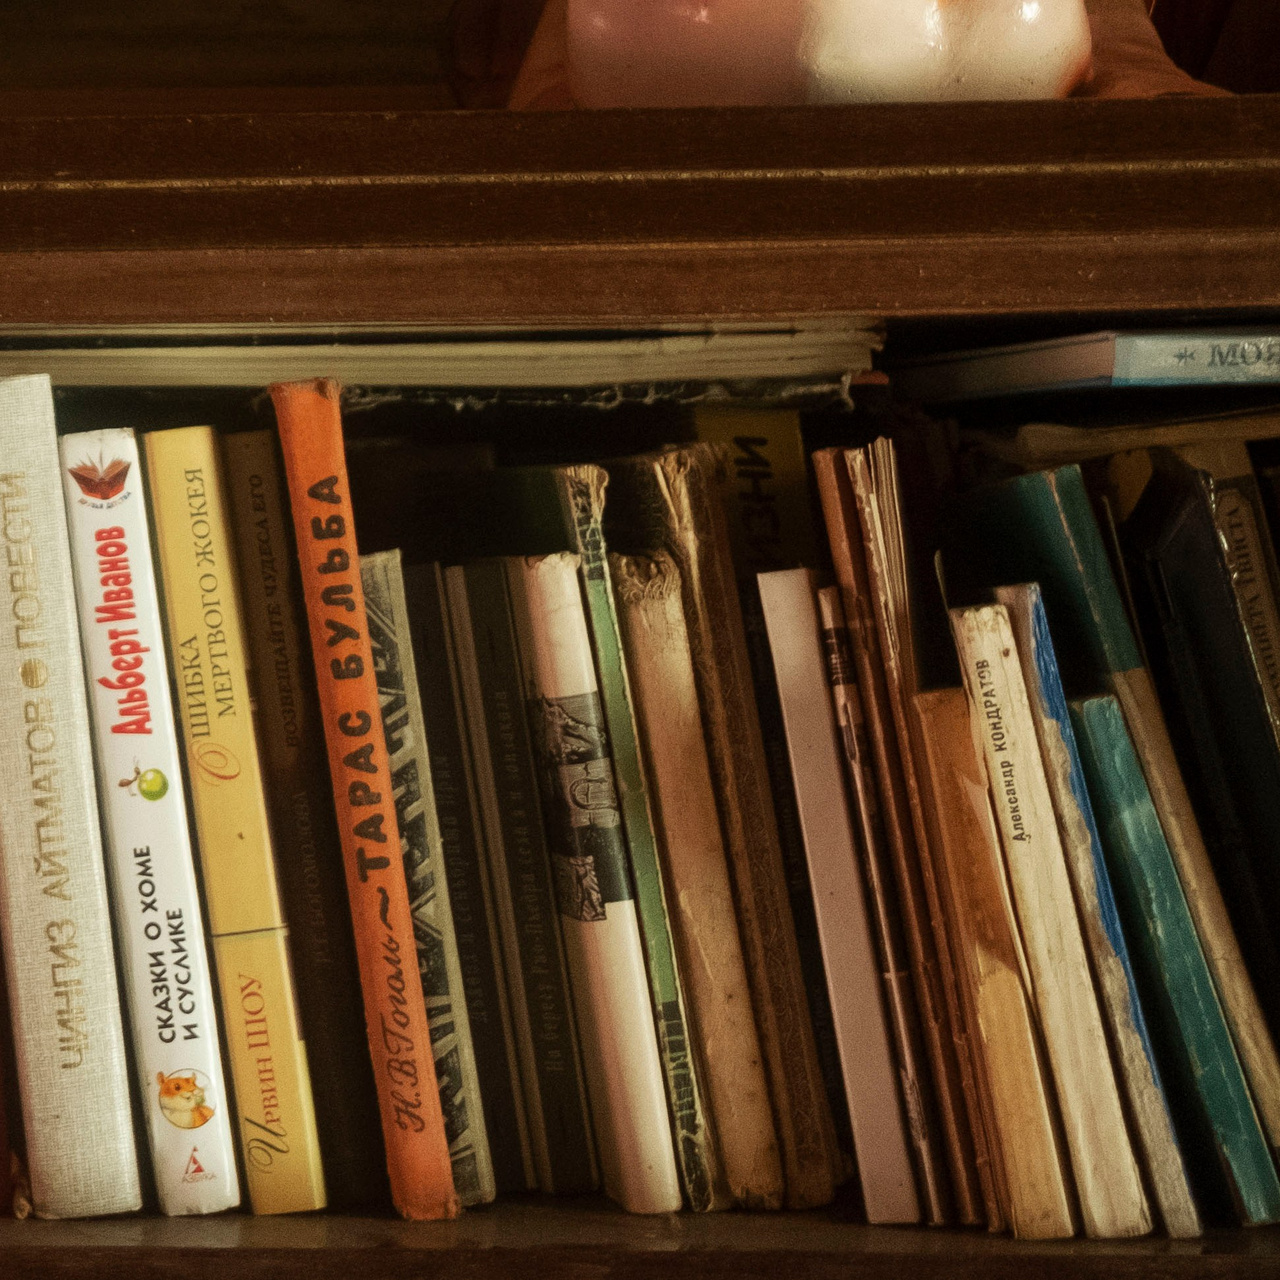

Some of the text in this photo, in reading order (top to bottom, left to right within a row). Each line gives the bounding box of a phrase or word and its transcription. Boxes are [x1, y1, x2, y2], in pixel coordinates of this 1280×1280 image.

[248, 474, 267, 513] ЕГО
[254, 517, 279, 598] ЧУДЕСА
[307, 475, 365, 681] БУЛЬБА
[94, 525, 154, 734] Альберт Иванов
[183, 468, 237, 717] МЕРТВОГО ЖОКЕЯ
[265, 602, 301, 748] ВОЗВЕЩАЙТЕ
[24, 696, 72, 902] АЙТМАТОВ
[338, 708, 390, 884] ТАРАС
[976, 658, 1028, 843] Александр КОНДРАТОВ
[44, 918, 90, 1069] ЧИНГИЗ
[133, 845, 176, 1044] СКАЗКИ О ХОМЕ
[166, 907, 200, 1041] И СУСЛИКЕ
[238, 973, 270, 1050] ШОУ
